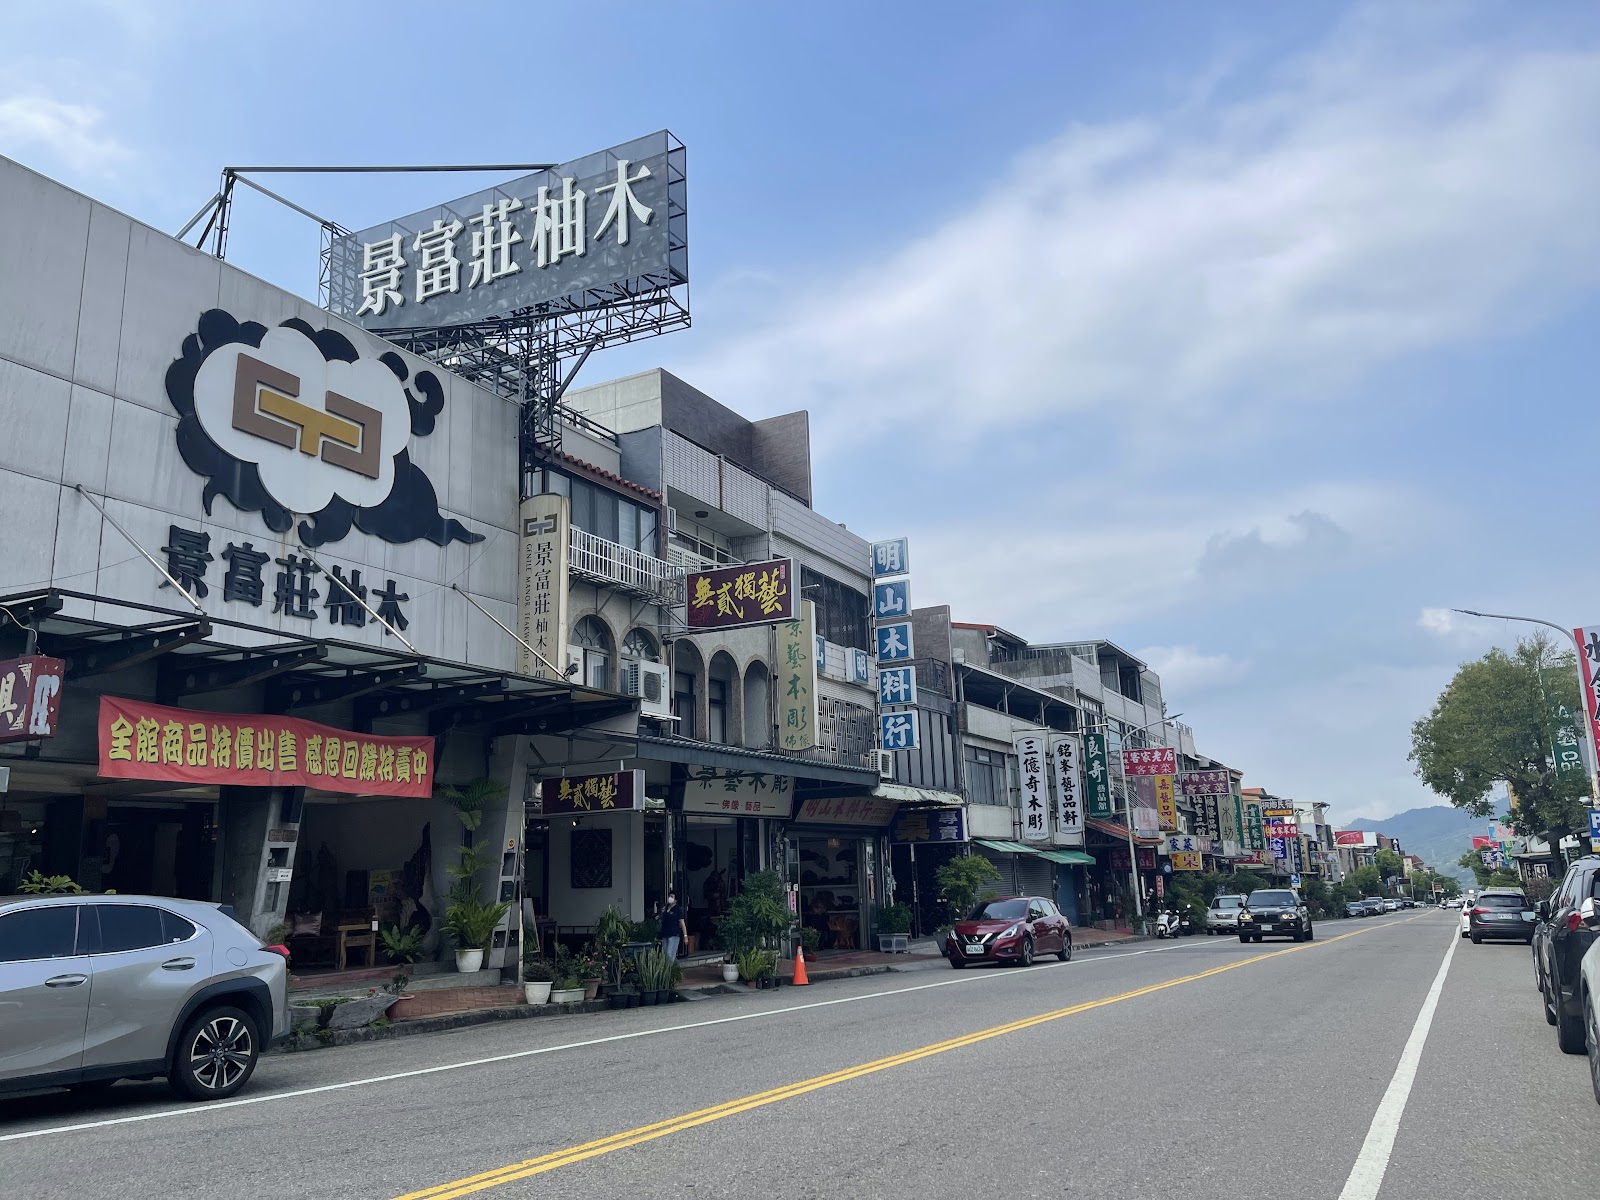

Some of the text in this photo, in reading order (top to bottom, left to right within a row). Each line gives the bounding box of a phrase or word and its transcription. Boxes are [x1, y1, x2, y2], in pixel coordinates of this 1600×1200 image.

[356, 160, 652, 316] 景富莊柚木
[159, 525, 409, 635] 景富莊柚木
[877, 544, 911, 747] 明山木料行
[1023, 740, 1043, 830] 三億奇木彫
